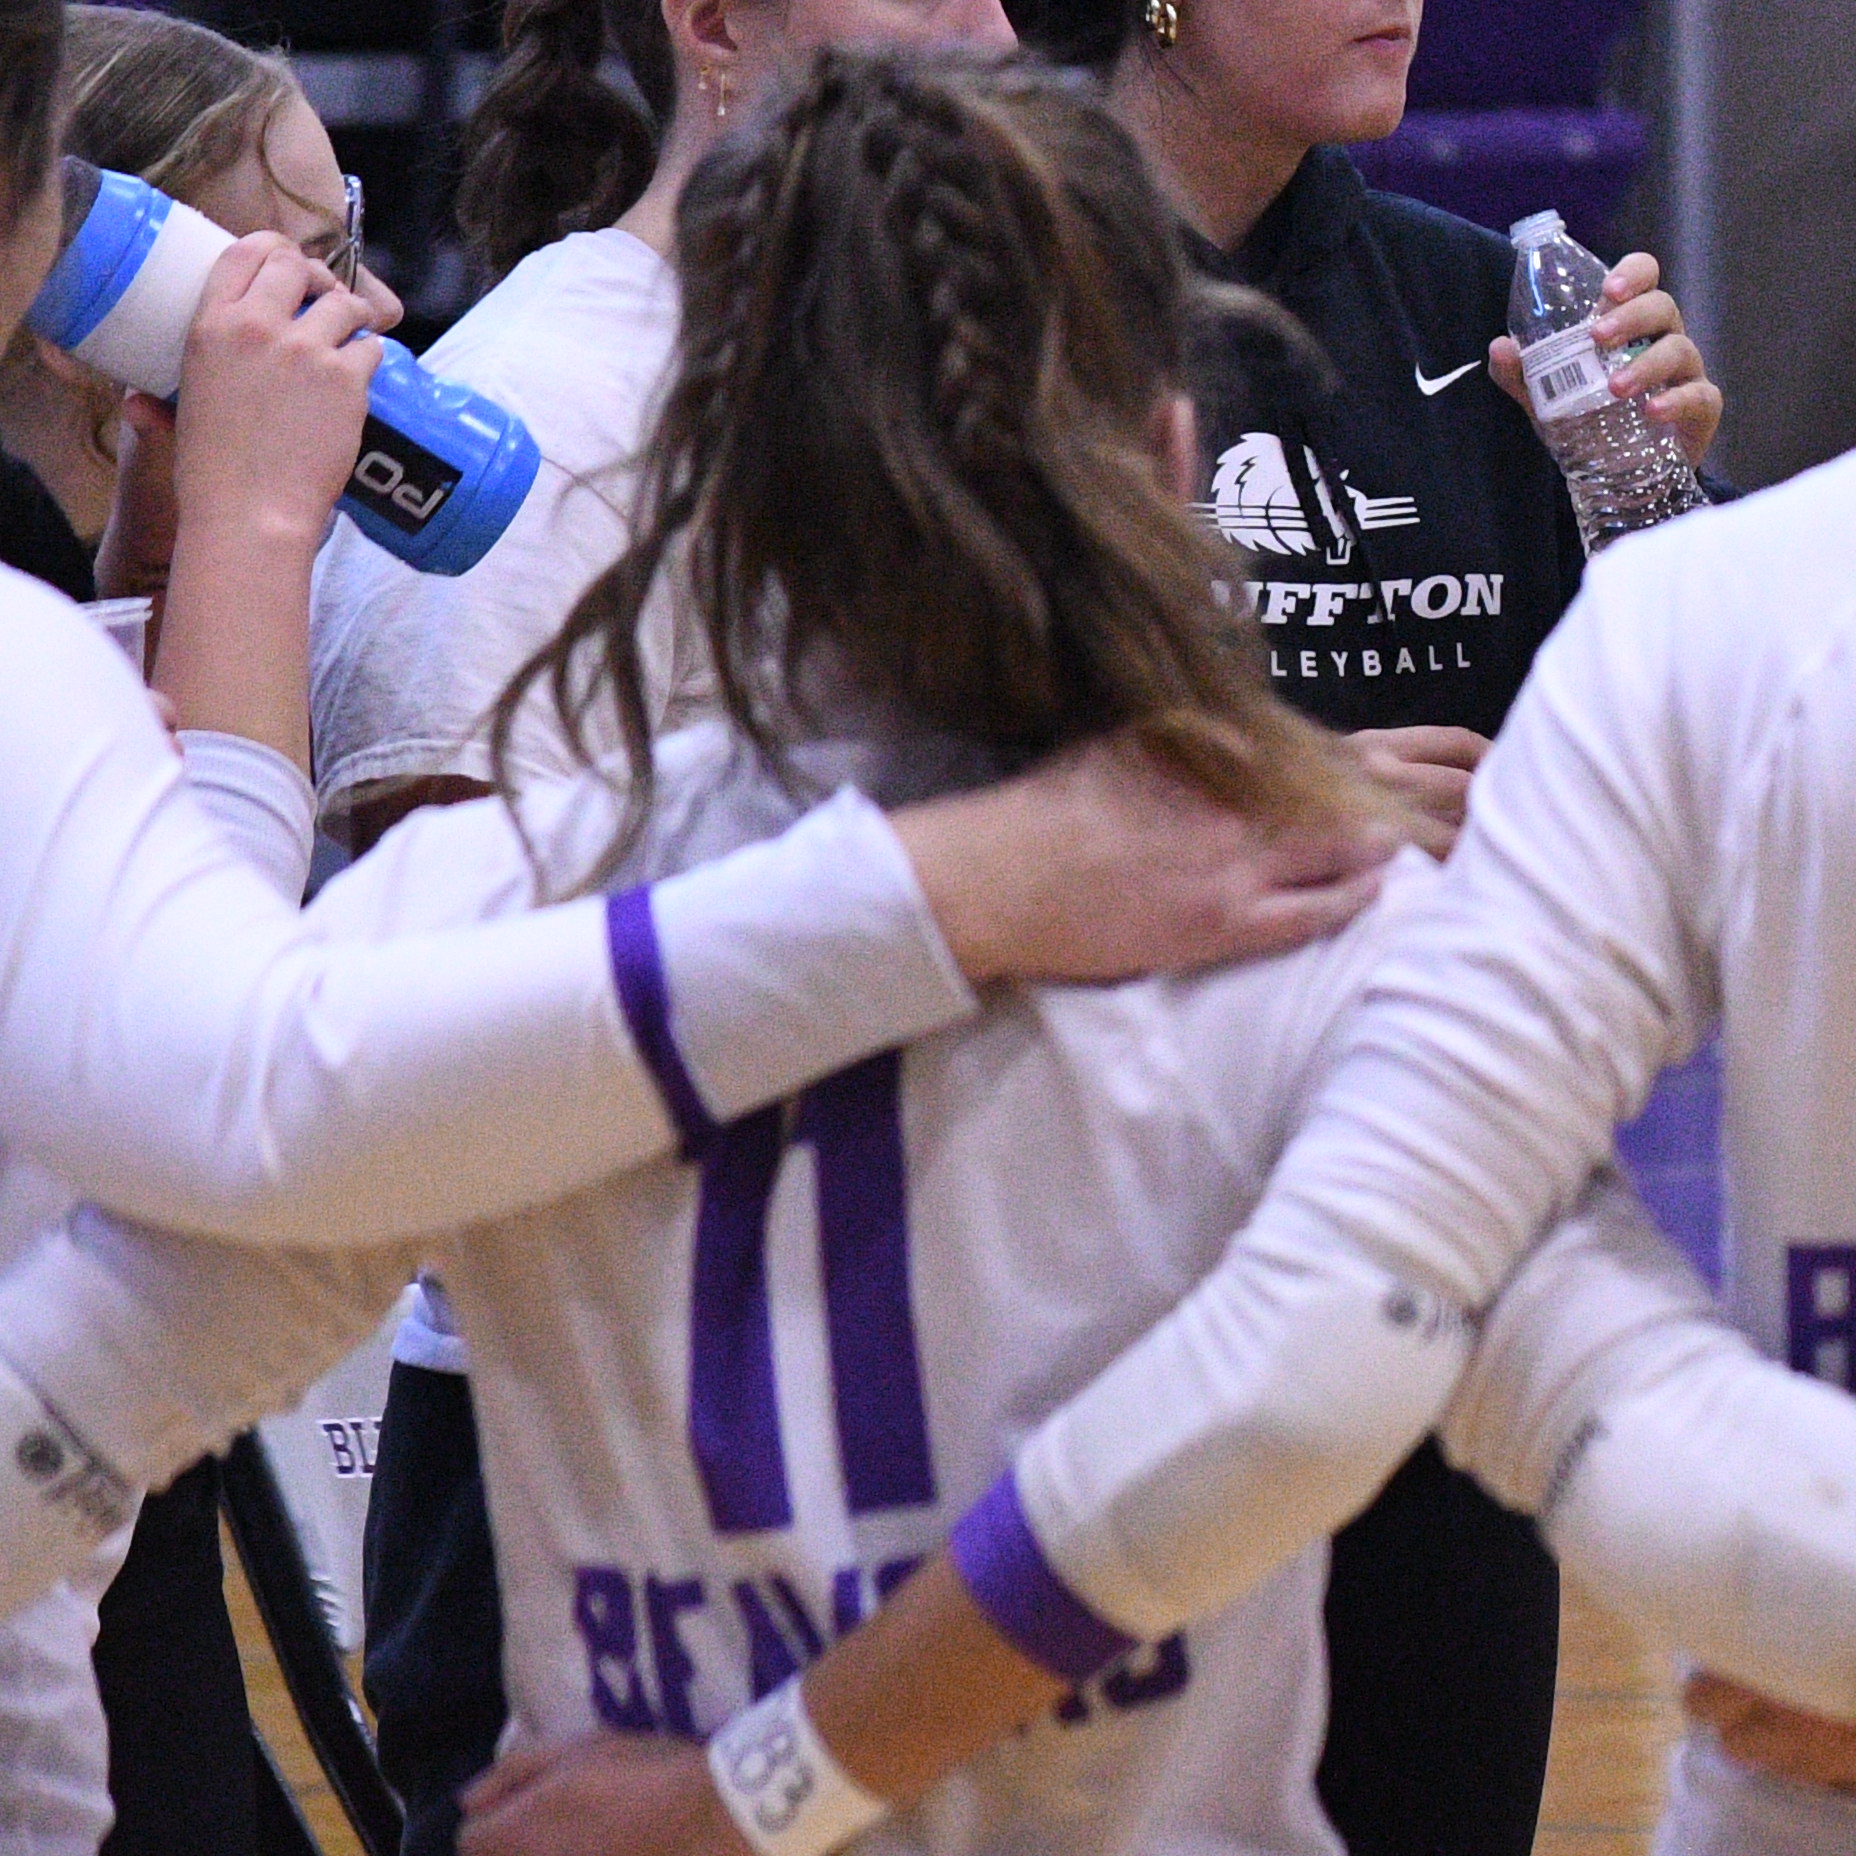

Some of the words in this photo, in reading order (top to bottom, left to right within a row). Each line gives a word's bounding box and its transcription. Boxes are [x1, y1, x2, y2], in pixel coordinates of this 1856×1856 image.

[356, 451, 453, 519] PO
[1270, 642, 1471, 678] LEYBALL
[318, 1418, 384, 1477] BL
